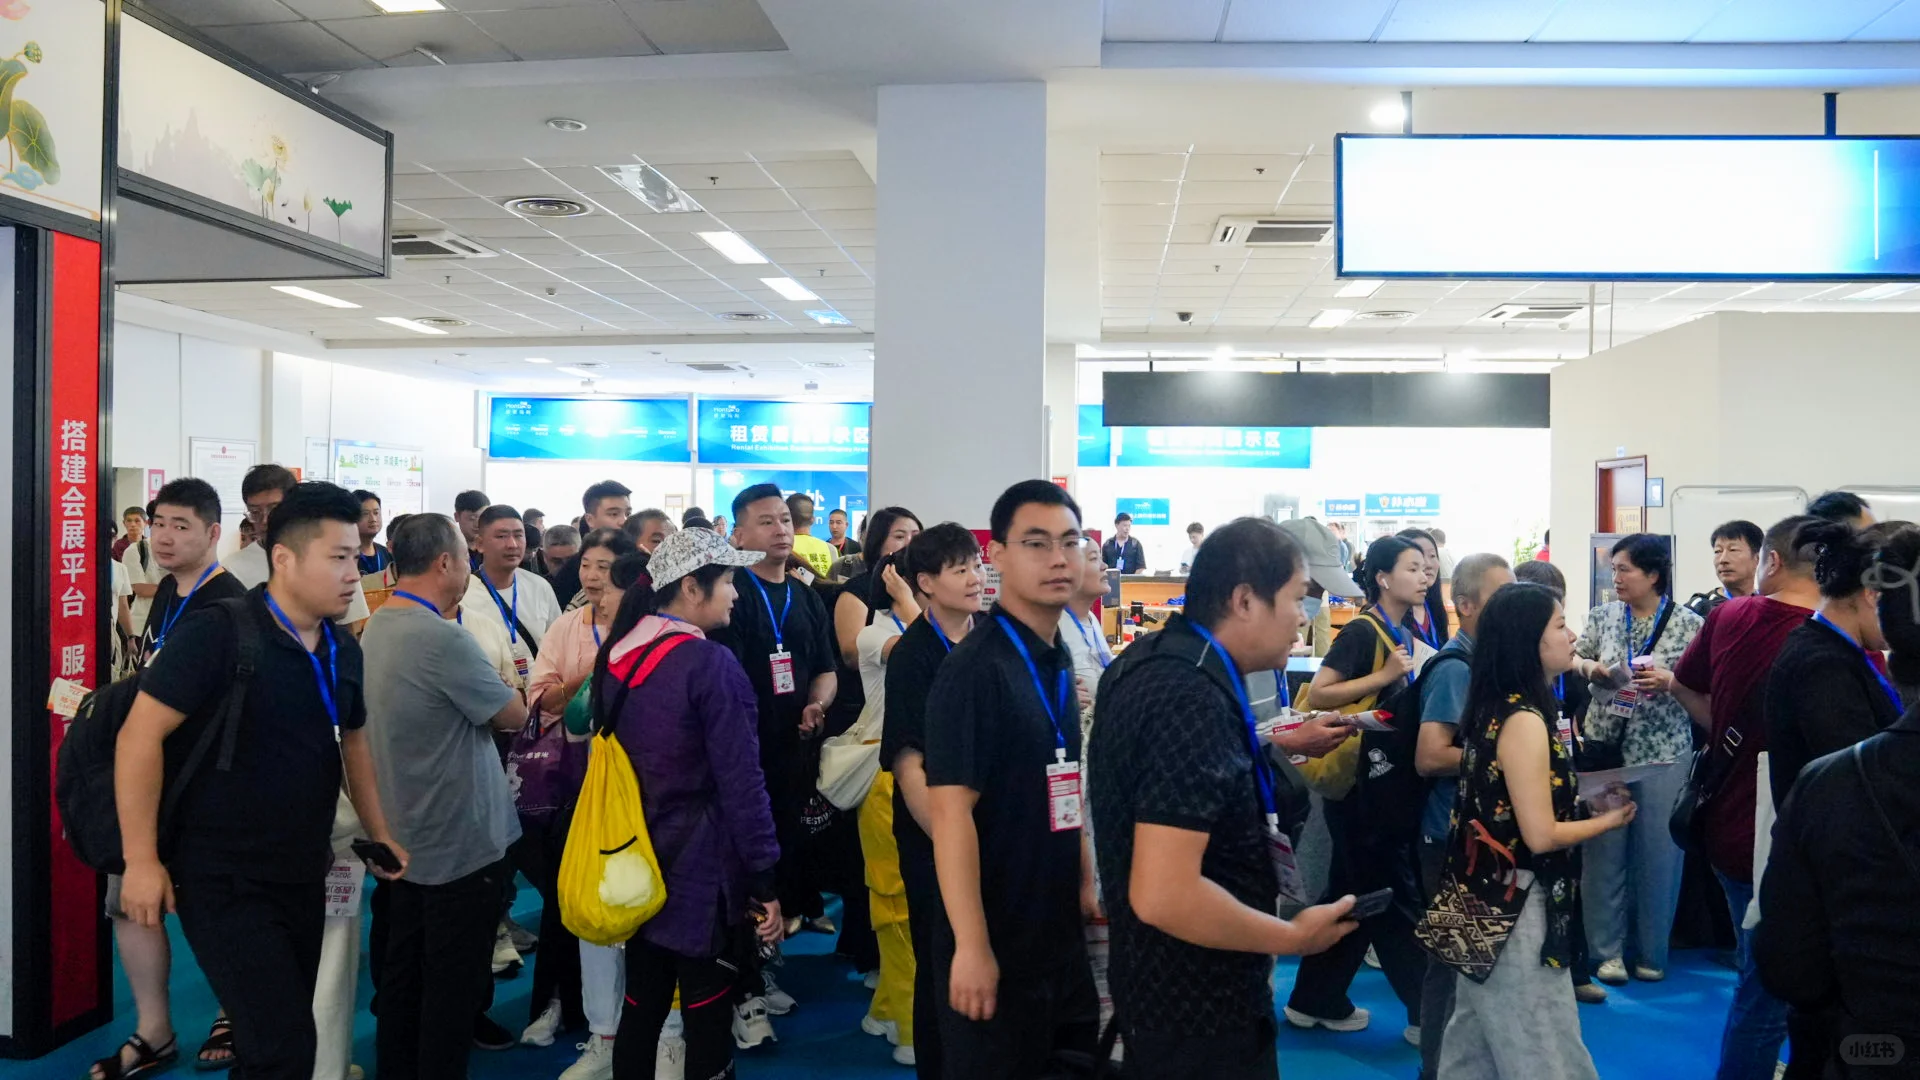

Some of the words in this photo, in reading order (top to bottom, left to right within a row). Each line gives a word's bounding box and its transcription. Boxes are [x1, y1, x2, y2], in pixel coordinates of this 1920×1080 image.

[61, 420, 87, 617] 搭建会展平台
[61, 644, 86, 686] 服
